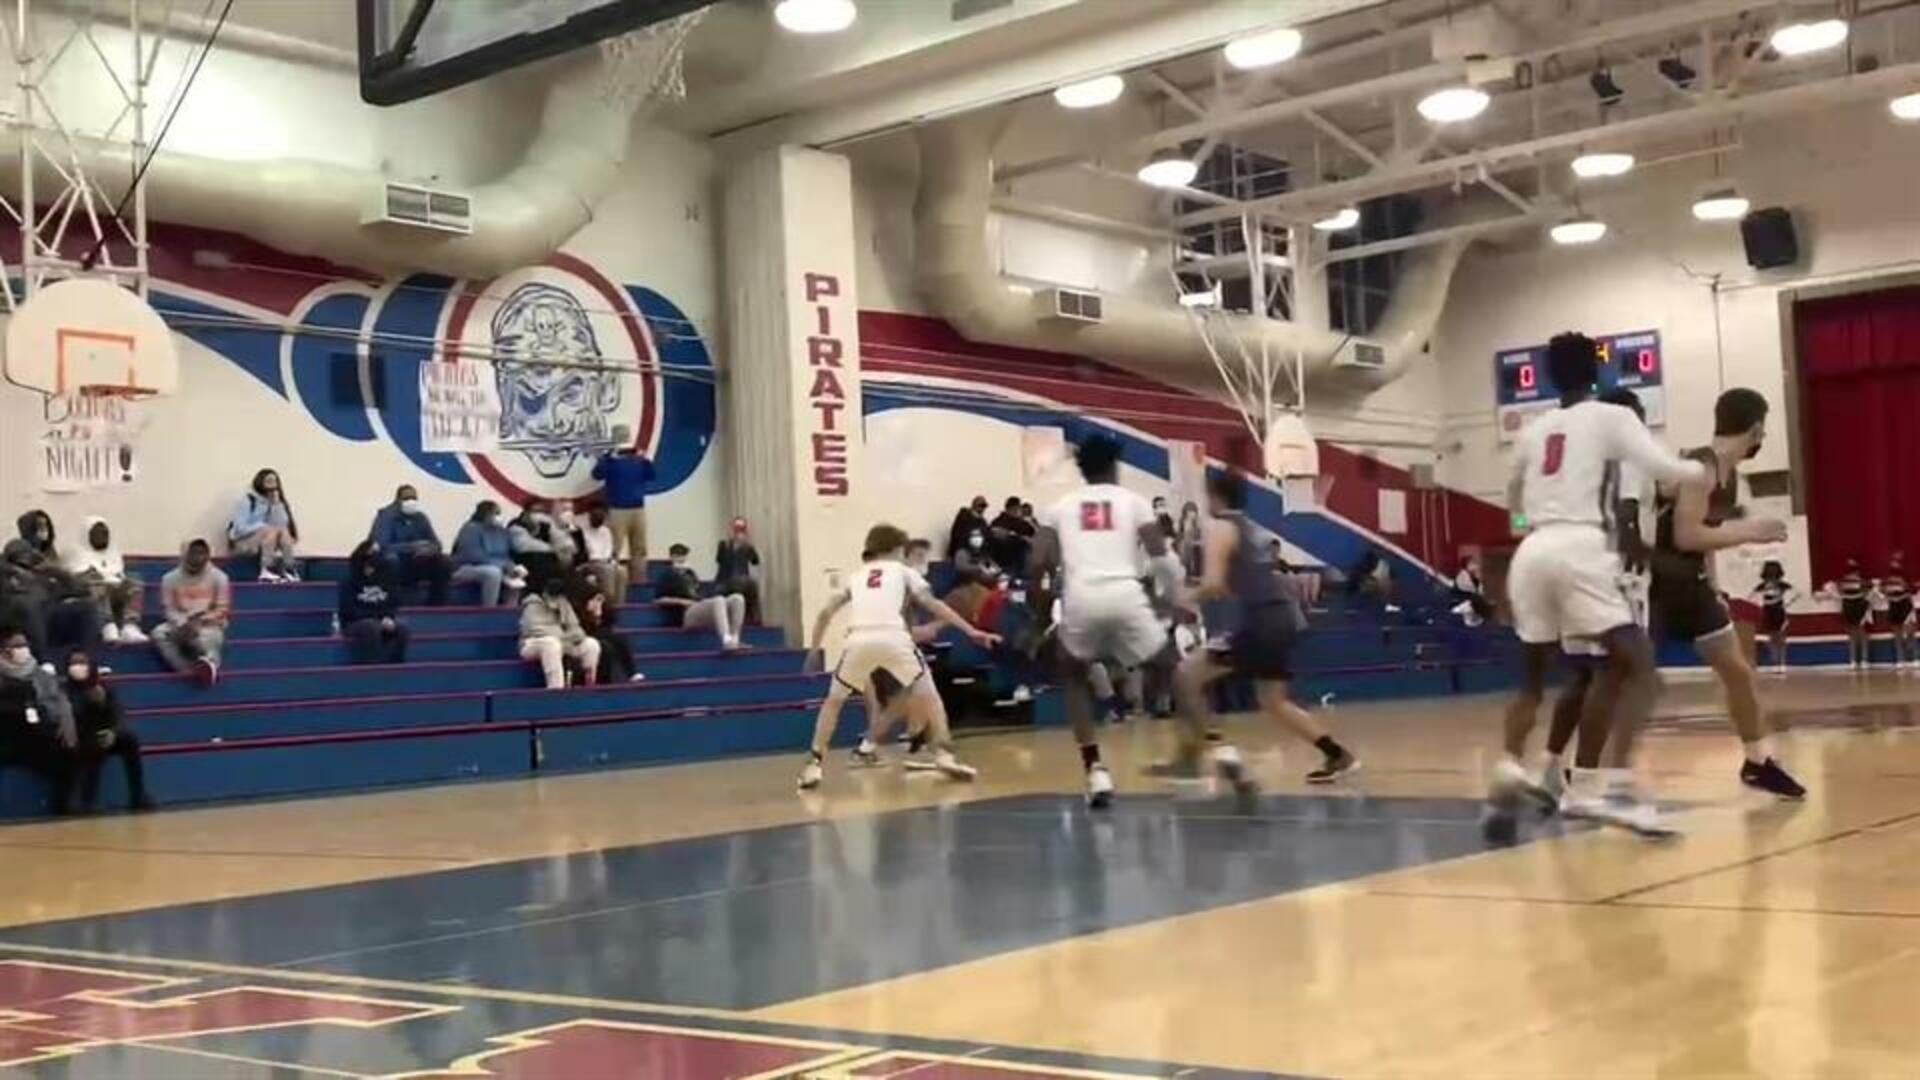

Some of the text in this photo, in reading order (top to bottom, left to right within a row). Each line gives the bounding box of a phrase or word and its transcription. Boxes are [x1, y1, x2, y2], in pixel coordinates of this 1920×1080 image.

[1638, 349, 1653, 372] 0
[804, 272, 849, 496] PIRATES
[1519, 364, 1535, 388] 0
[1081, 500, 1113, 531] 21
[867, 568, 883, 589] 2
